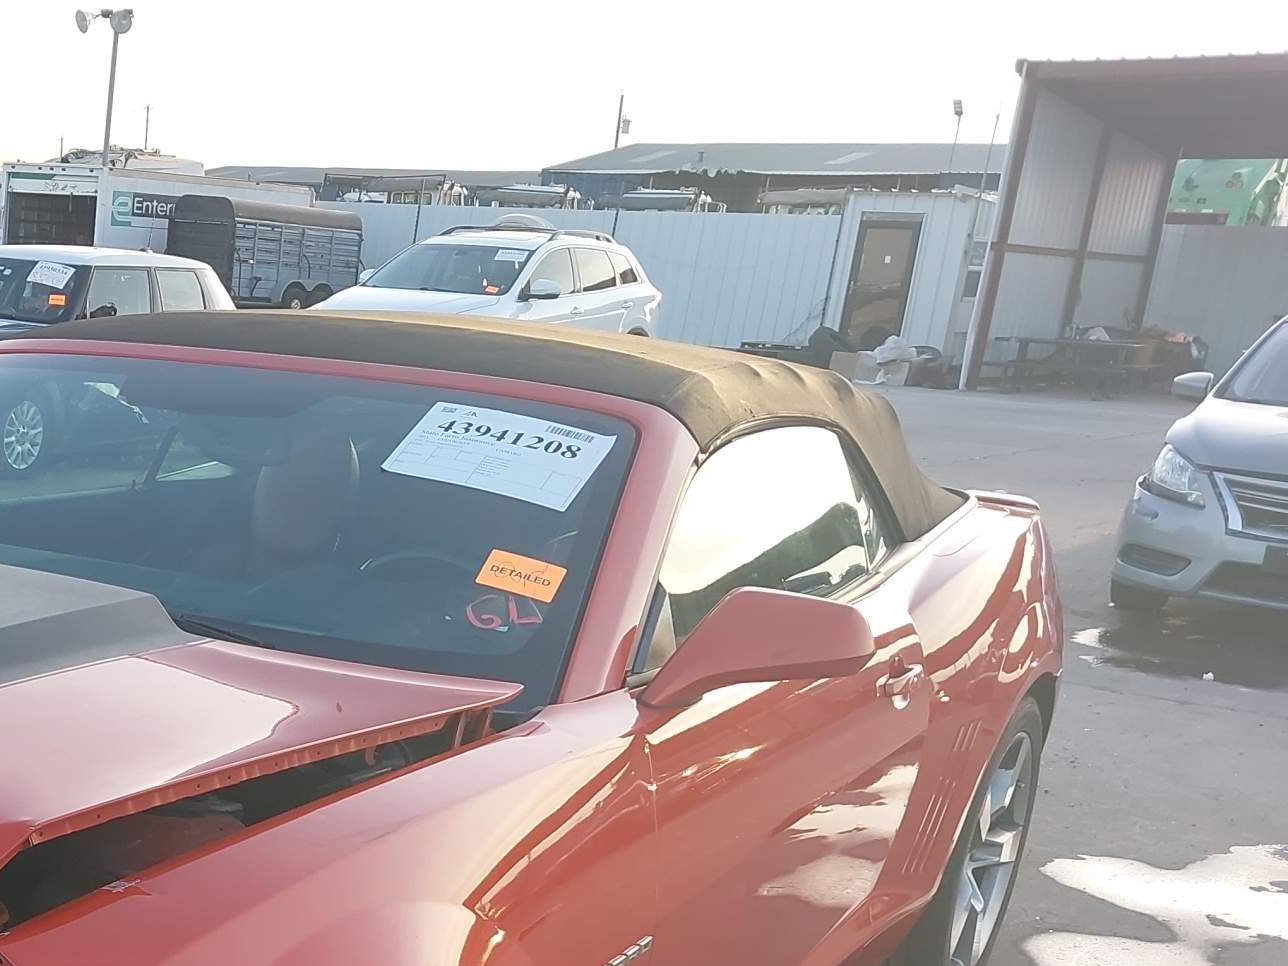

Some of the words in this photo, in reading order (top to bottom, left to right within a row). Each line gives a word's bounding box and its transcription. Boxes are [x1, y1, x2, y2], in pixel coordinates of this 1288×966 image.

[133, 197, 176, 216] Enter
[437, 419, 582, 460] 43941208
[490, 564, 551, 587] DETAILED
